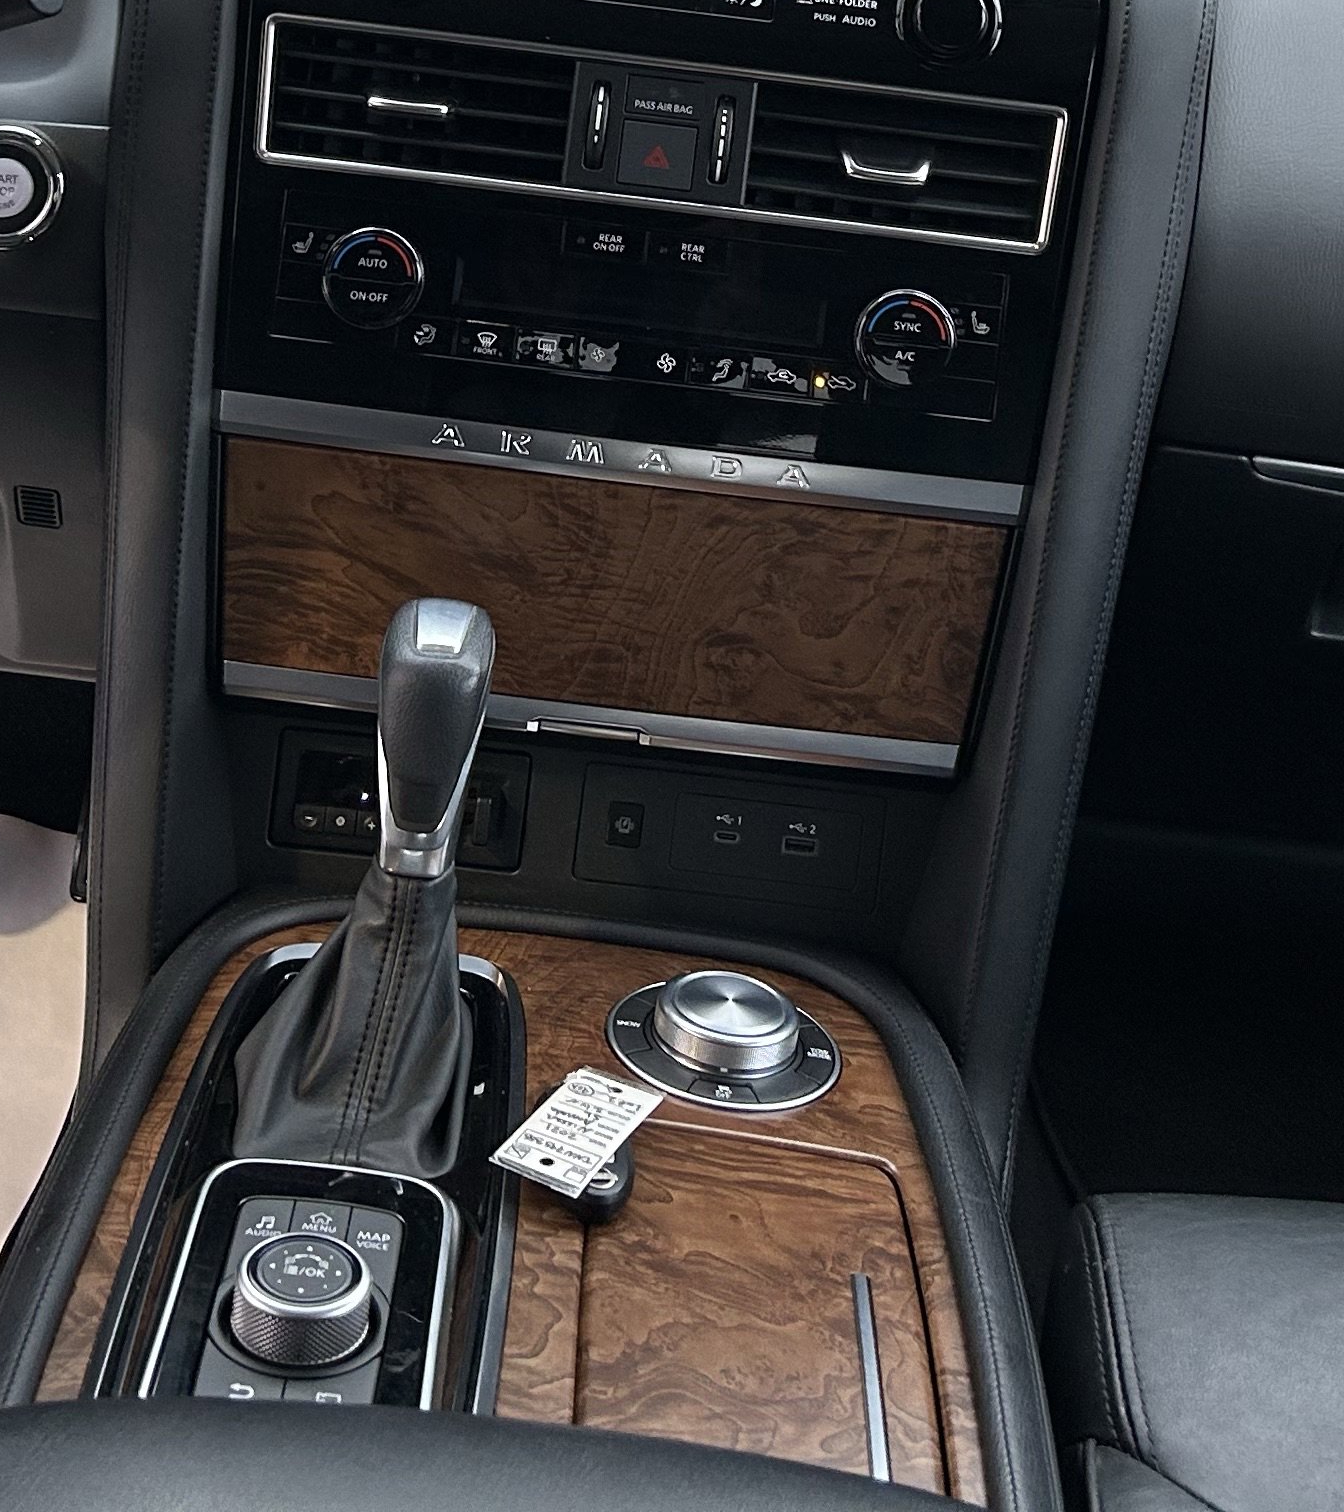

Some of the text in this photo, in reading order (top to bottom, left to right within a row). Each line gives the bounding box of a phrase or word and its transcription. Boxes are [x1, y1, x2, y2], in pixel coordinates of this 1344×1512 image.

[813, 12, 877, 27] PUSH AUDIO
[634, 99, 656, 110] PASS
[599, 233, 623, 244] REAR
[681, 243, 705, 253] REAR
[357, 257, 388, 269] AUTO
[680, 252, 703, 263] CTRL
[893, 320, 922, 333] SYNC
[473, 346, 497, 356] FRONT
[894, 350, 916, 362] A/C
[432, 423, 810, 489] ARMADA
[809, 823, 817, 834] 2
[244, 1227, 282, 1237] AUDIO
[301, 1222, 337, 1234] MENU
[356, 1230, 391, 1242] MAP
[356, 1240, 389, 1252] VOICE
